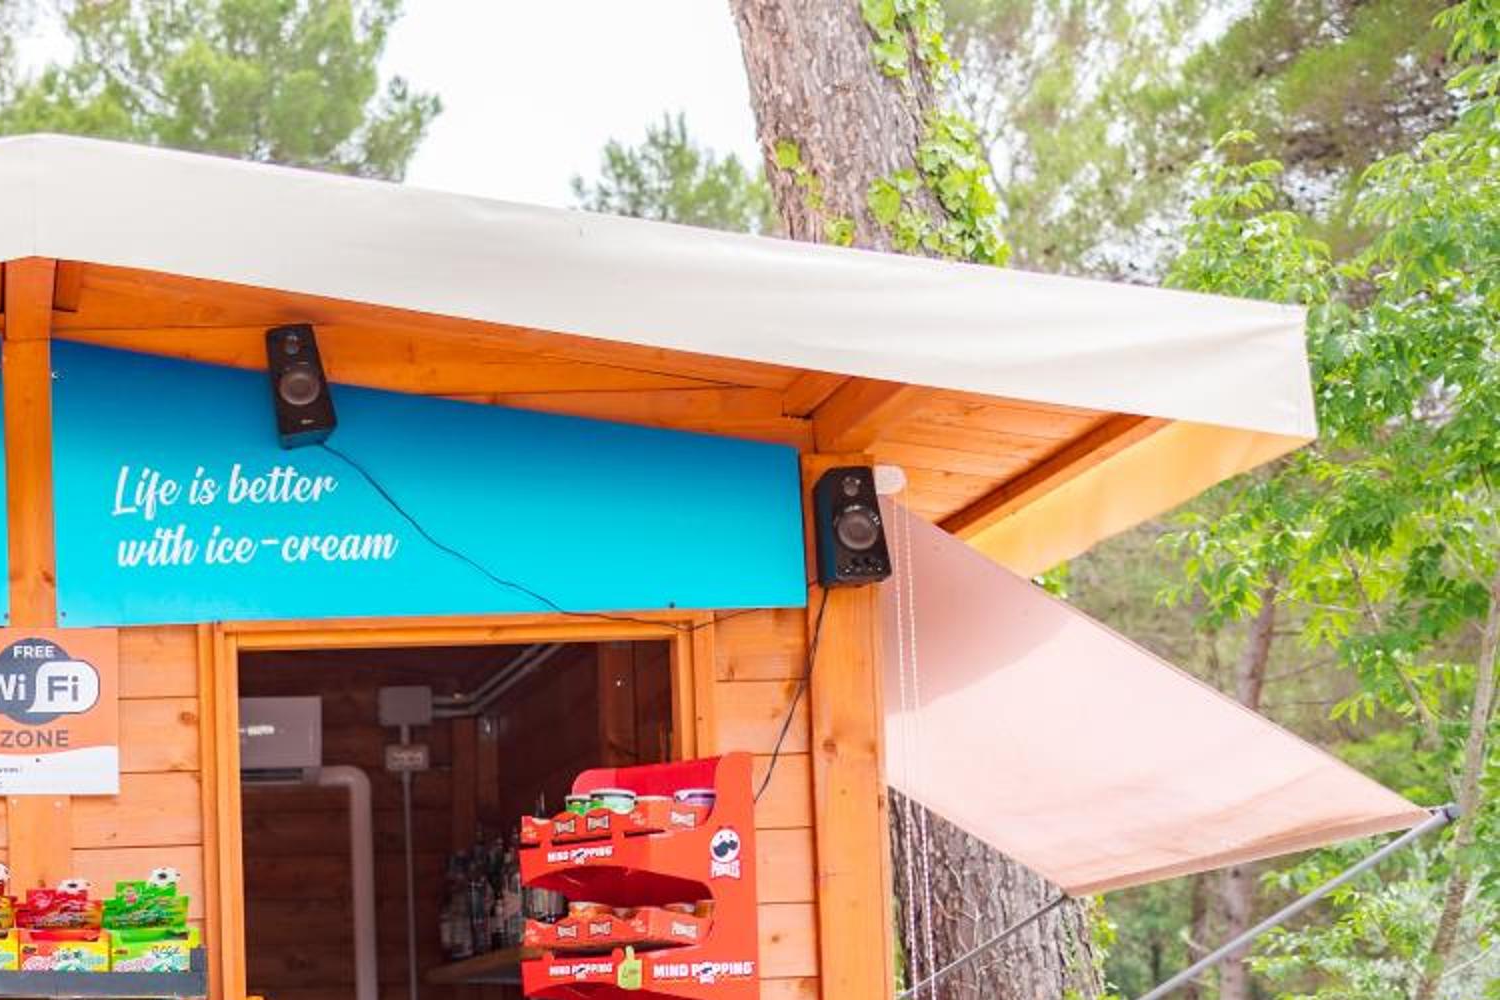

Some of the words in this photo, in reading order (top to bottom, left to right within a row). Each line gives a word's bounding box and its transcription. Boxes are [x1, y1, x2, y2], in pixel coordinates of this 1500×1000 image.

[111, 466, 181, 520] Life
[188, 466, 221, 505] is
[227, 464, 338, 503] better
[117, 524, 198, 567] with
[204, 526, 399, 564] ice-cream
[13, 645, 54, 659] FREE
[0, 729, 69, 748] ZONE
[653, 963, 689, 978] MIND
